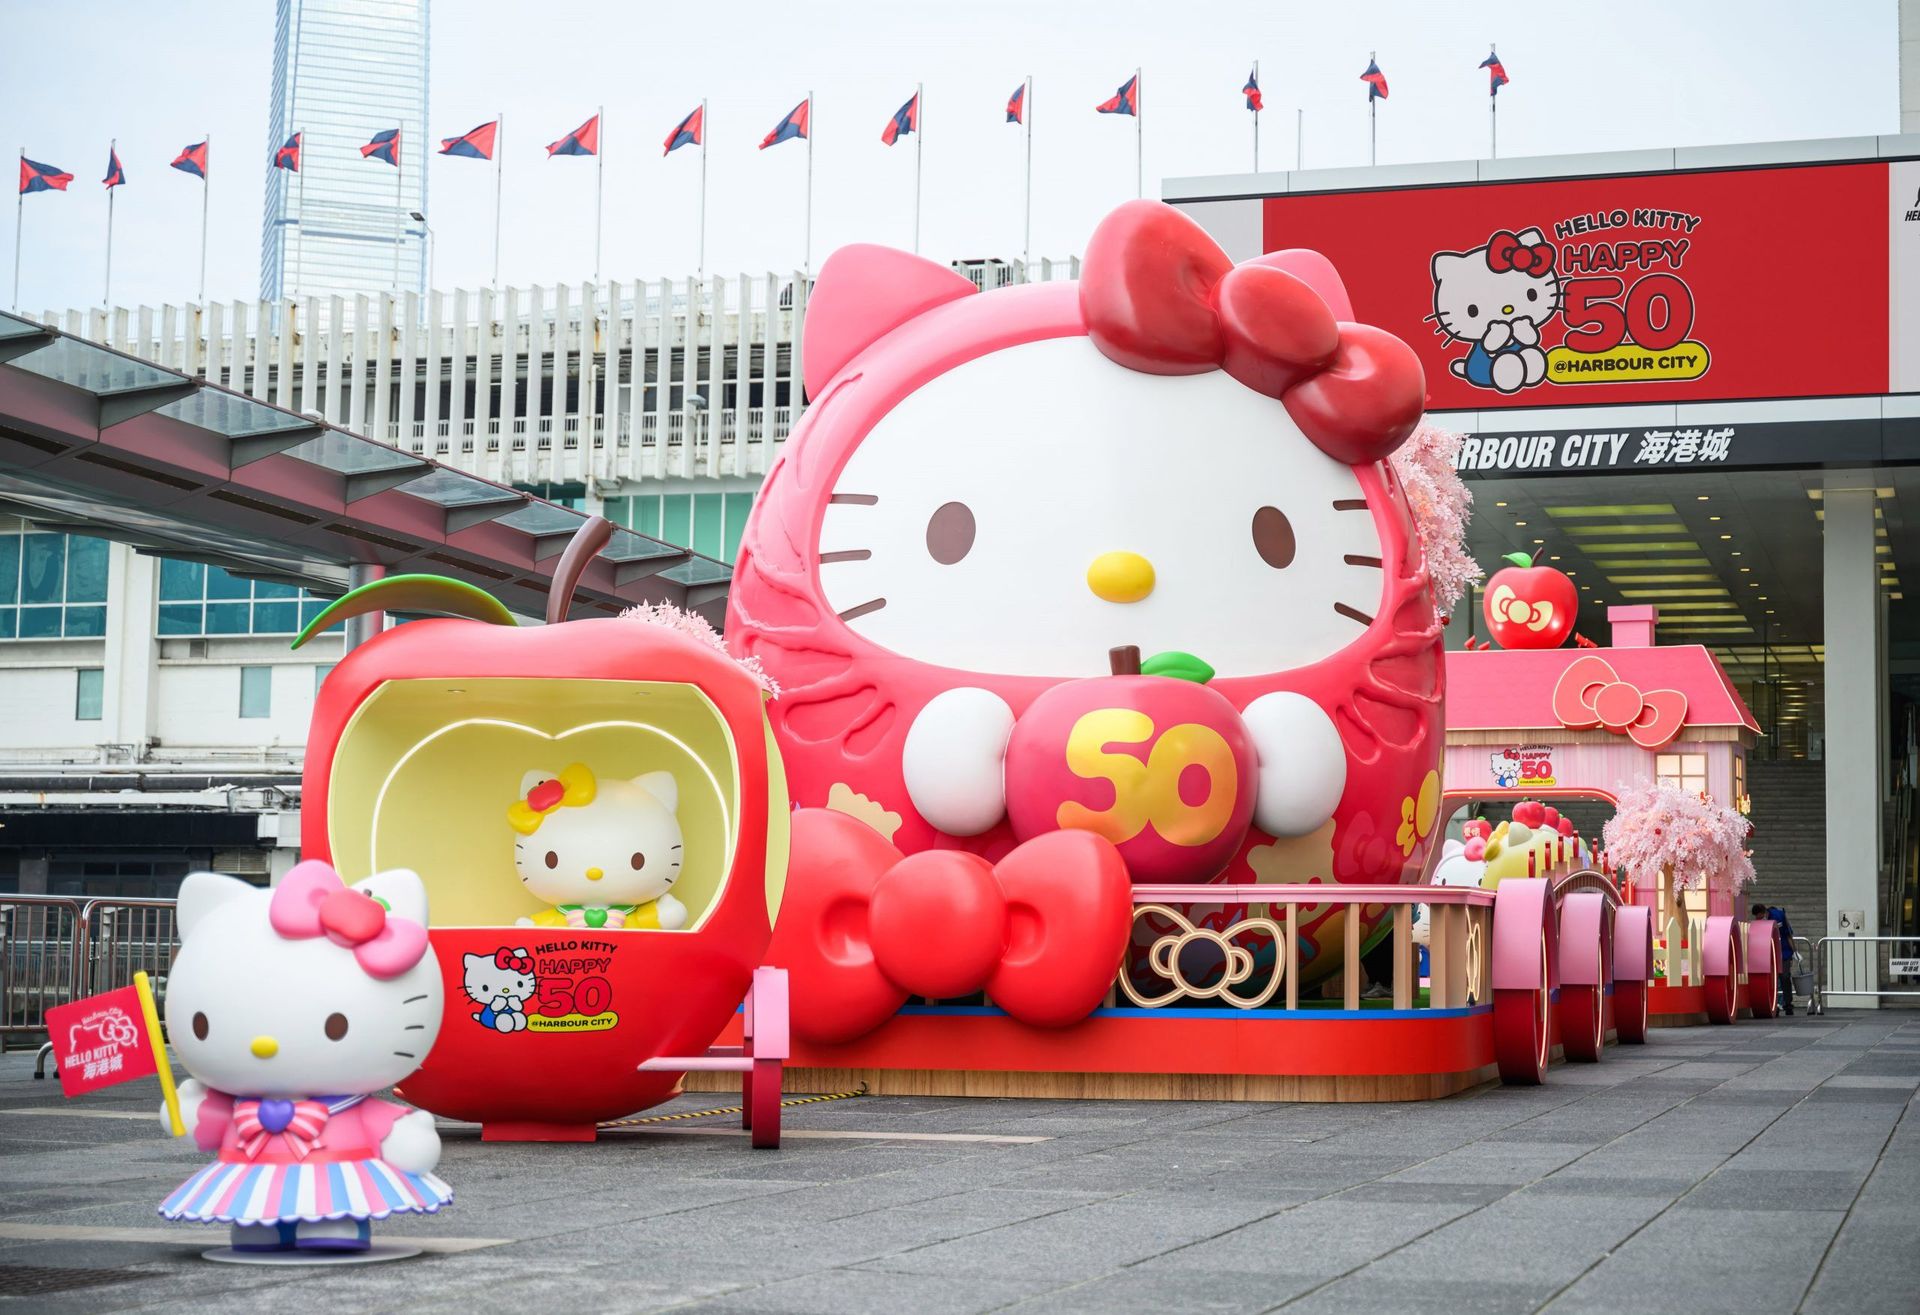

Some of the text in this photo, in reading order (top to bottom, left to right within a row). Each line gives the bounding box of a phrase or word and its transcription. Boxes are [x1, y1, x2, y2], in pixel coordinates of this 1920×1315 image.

[1554, 208, 1701, 240] HELLO KITTY
[1562, 239, 1690, 273] HAPPY
[1562, 272, 1695, 353] 50
[1554, 355, 1698, 373] @HARBOUR CITY
[1560, 433, 1629, 467] CITY
[1633, 427, 1735, 465] 海港城
[1056, 707, 1238, 848] 50
[1521, 761, 1552, 779] 50
[535, 940, 618, 955] HELLO KITTY
[539, 957, 612, 974] HAPPY
[538, 976, 612, 1018] 50
[590, 1018, 613, 1026] CITY
[64, 1042, 119, 1069] HELLO KITTY
